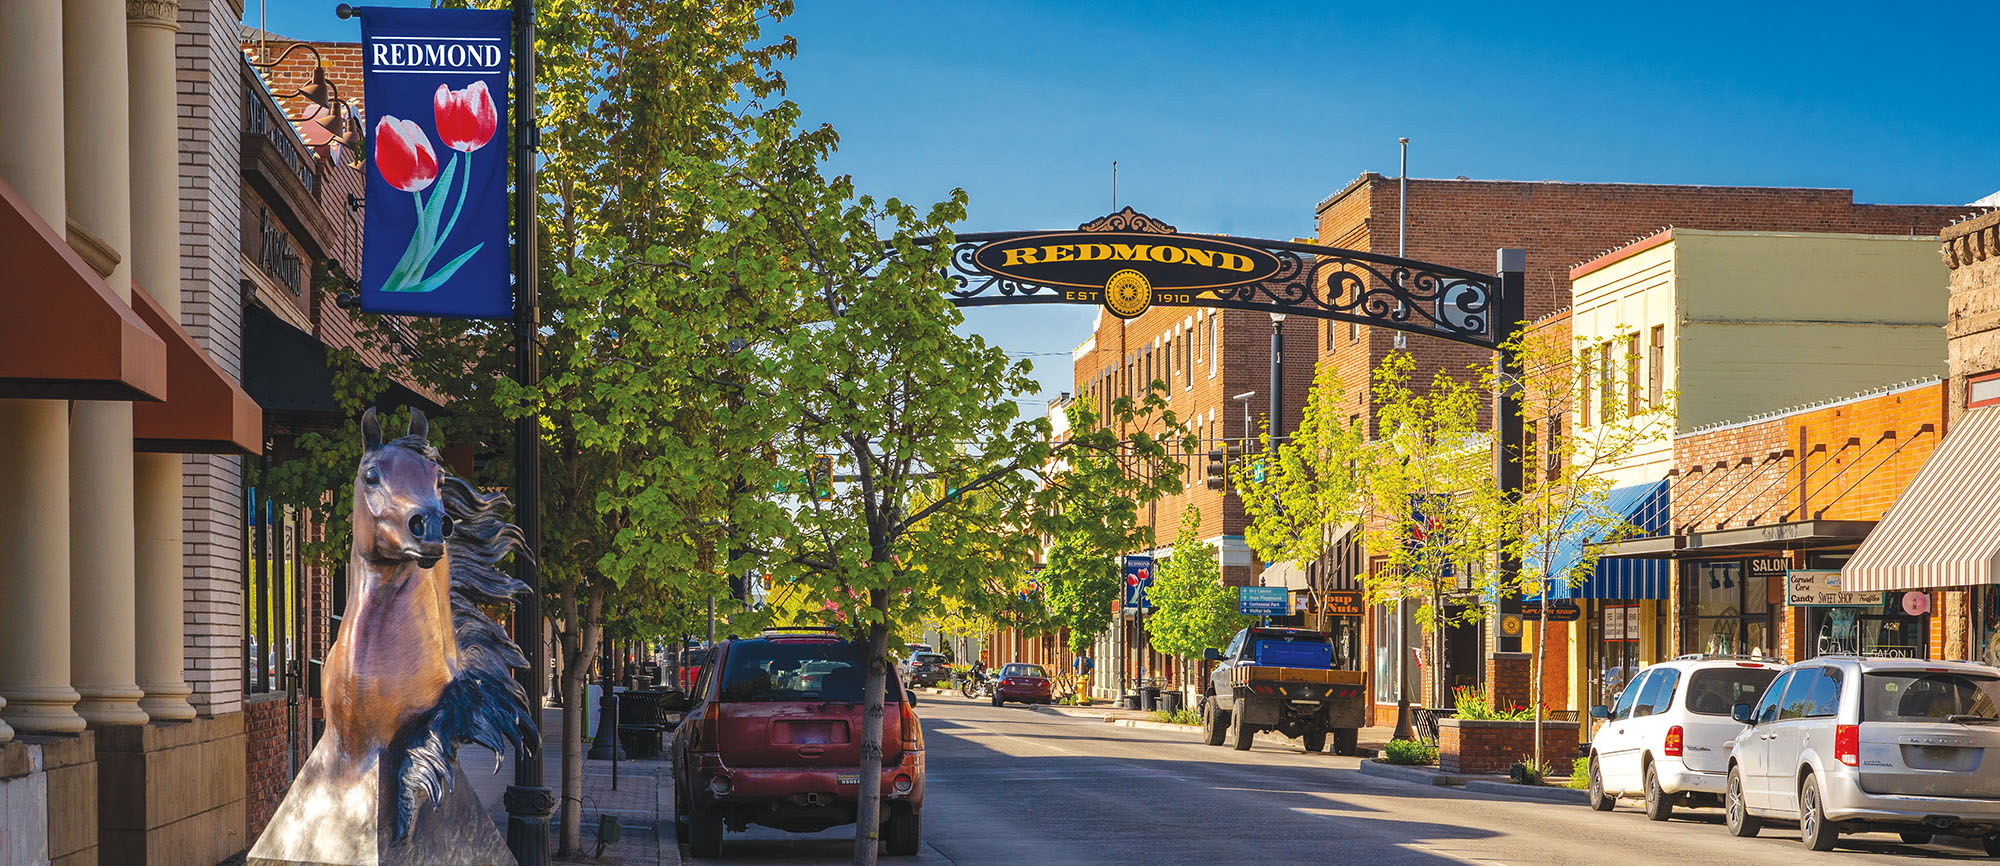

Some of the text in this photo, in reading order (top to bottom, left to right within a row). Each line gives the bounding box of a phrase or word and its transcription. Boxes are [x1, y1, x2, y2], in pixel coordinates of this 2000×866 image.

[372, 43, 502, 67] REDMOND
[1002, 243, 1255, 273] REDMOND
[1116, 278, 1141, 289] REDMOND
[1066, 291, 1190, 303] EST 1910
[1752, 558, 1789, 572] SALON
[1790, 574, 1815, 584] Caramel
[1795, 583, 1810, 591] Corn
[1322, 596, 1352, 605] oup
[1790, 591, 1880, 604] Candy SWEET SHOP Truffles
[1327, 603, 1359, 613] Nuts
[1883, 622, 1901, 631] 427
